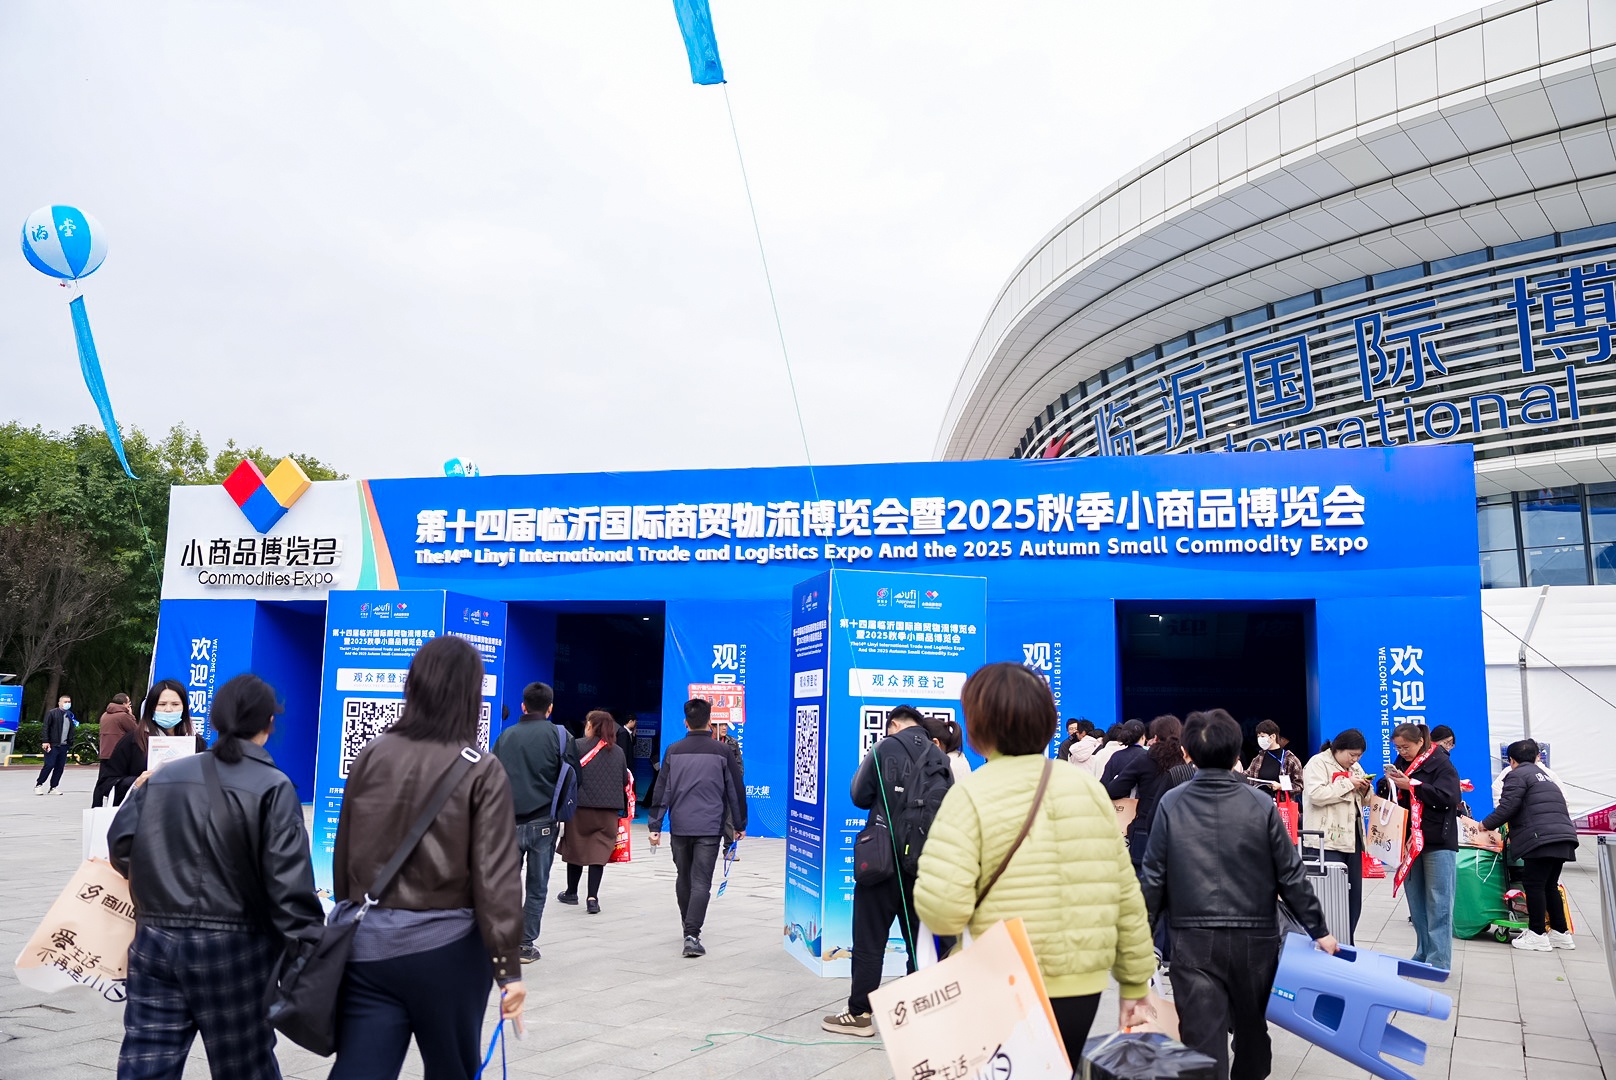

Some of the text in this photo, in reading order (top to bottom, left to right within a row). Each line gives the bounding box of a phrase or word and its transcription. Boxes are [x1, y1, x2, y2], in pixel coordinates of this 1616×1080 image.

[1095, 262, 1616, 456] 临沂国际博
[415, 484, 1366, 543] 第十四届临沂国际商贸物流博览会暨2025秋季小商品博览会
[181, 536, 337, 567] 小商品博览会
[474, 547, 515, 567] Linyi
[519, 546, 633, 563] International
[638, 544, 690, 562] Trade
[695, 544, 730, 561] and
[735, 544, 819, 564] Logistics
[824, 543, 873, 563] Expo
[879, 541, 918, 559] And
[924, 541, 957, 558] the
[963, 540, 1013, 558] 2025
[1019, 539, 1101, 557] Autumn
[1107, 536, 1168, 555] Small
[1175, 534, 1302, 556] Commodity
[1310, 534, 1369, 555] Expo
[198, 570, 334, 588] Commodities Expo
[840, 618, 977, 635] 第十四届临沂国际商贸物流博览会
[856, 629, 961, 644] 暨2025秋季小商品博览会
[210, 638, 219, 673] WELCOME
[208, 673, 216, 684] TO
[872, 674, 945, 689] 观众预登记
[1378, 646, 1388, 692] WELCOME
[207, 685, 215, 699] THE
[1380, 693, 1389, 706] TO
[1381, 707, 1390, 726] THE
[51, 928, 102, 969] 爱生活
[912, 980, 963, 1015] 商小白
